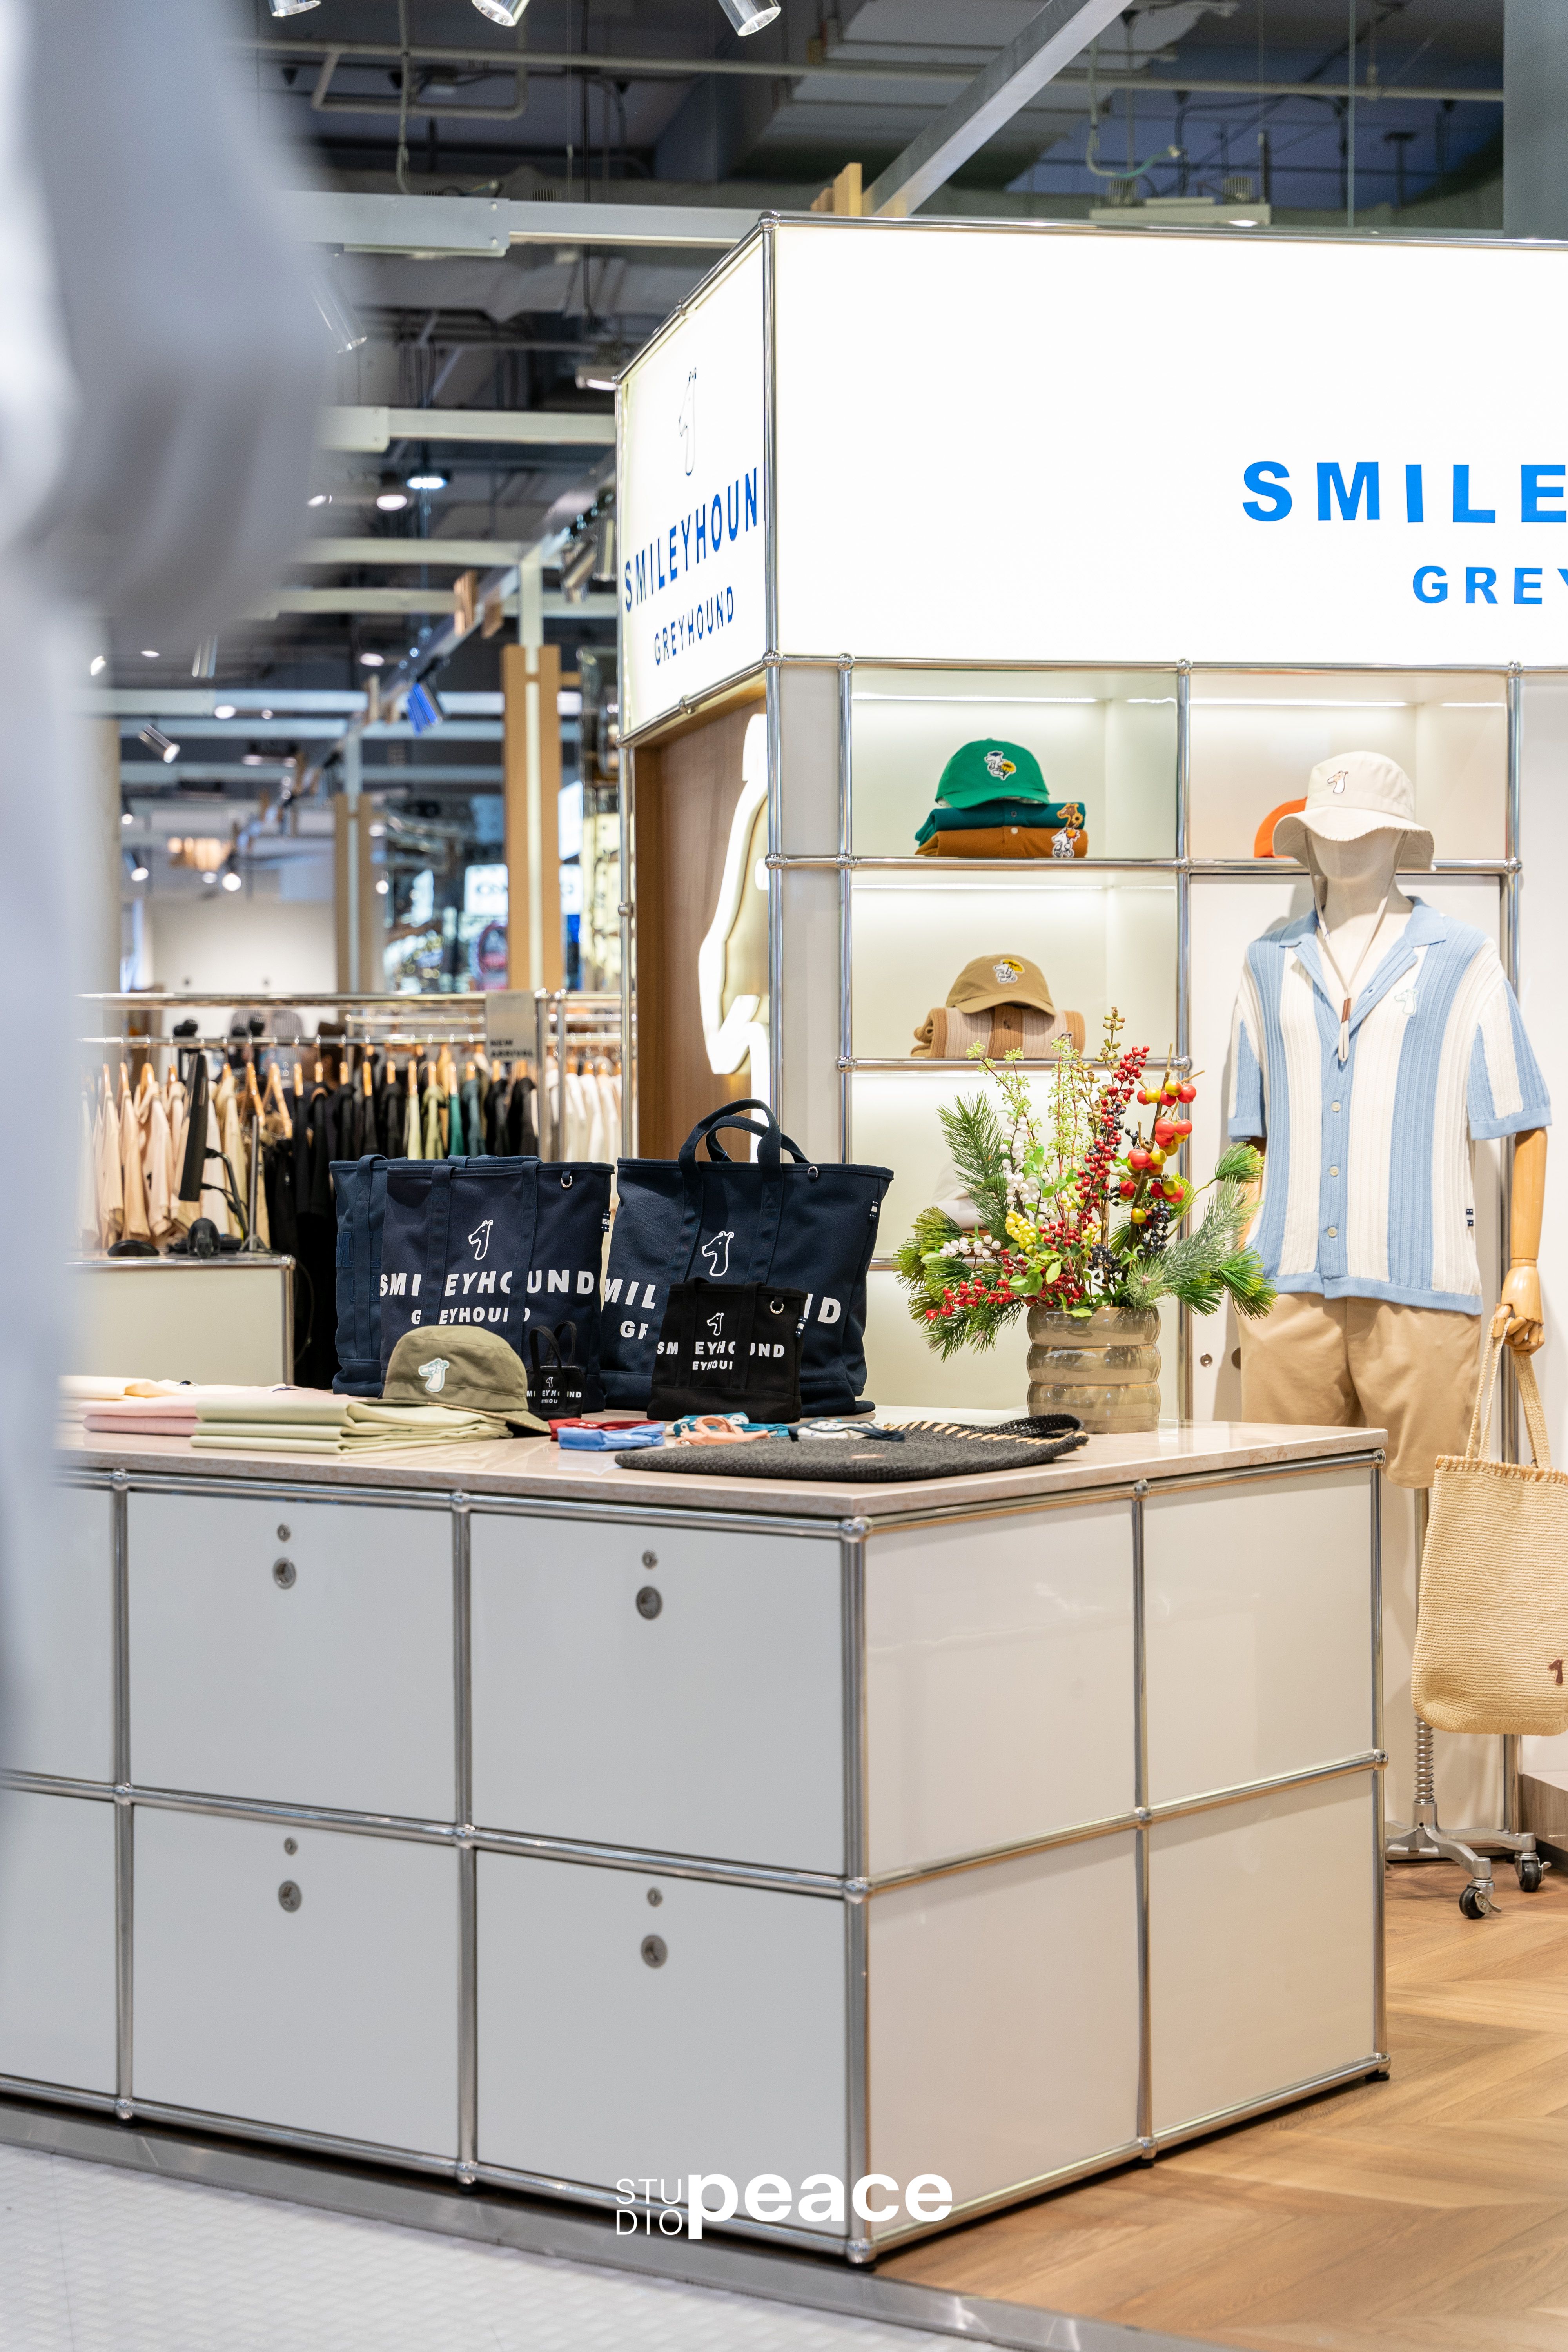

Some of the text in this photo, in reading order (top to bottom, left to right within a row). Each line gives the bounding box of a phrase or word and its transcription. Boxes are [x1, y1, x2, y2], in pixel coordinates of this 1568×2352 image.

[625, 462, 765, 612] SMILEYHOUN
[655, 586, 733, 666] GREYHOUND
[380, 1270, 594, 1297] SMIEYHOUND
